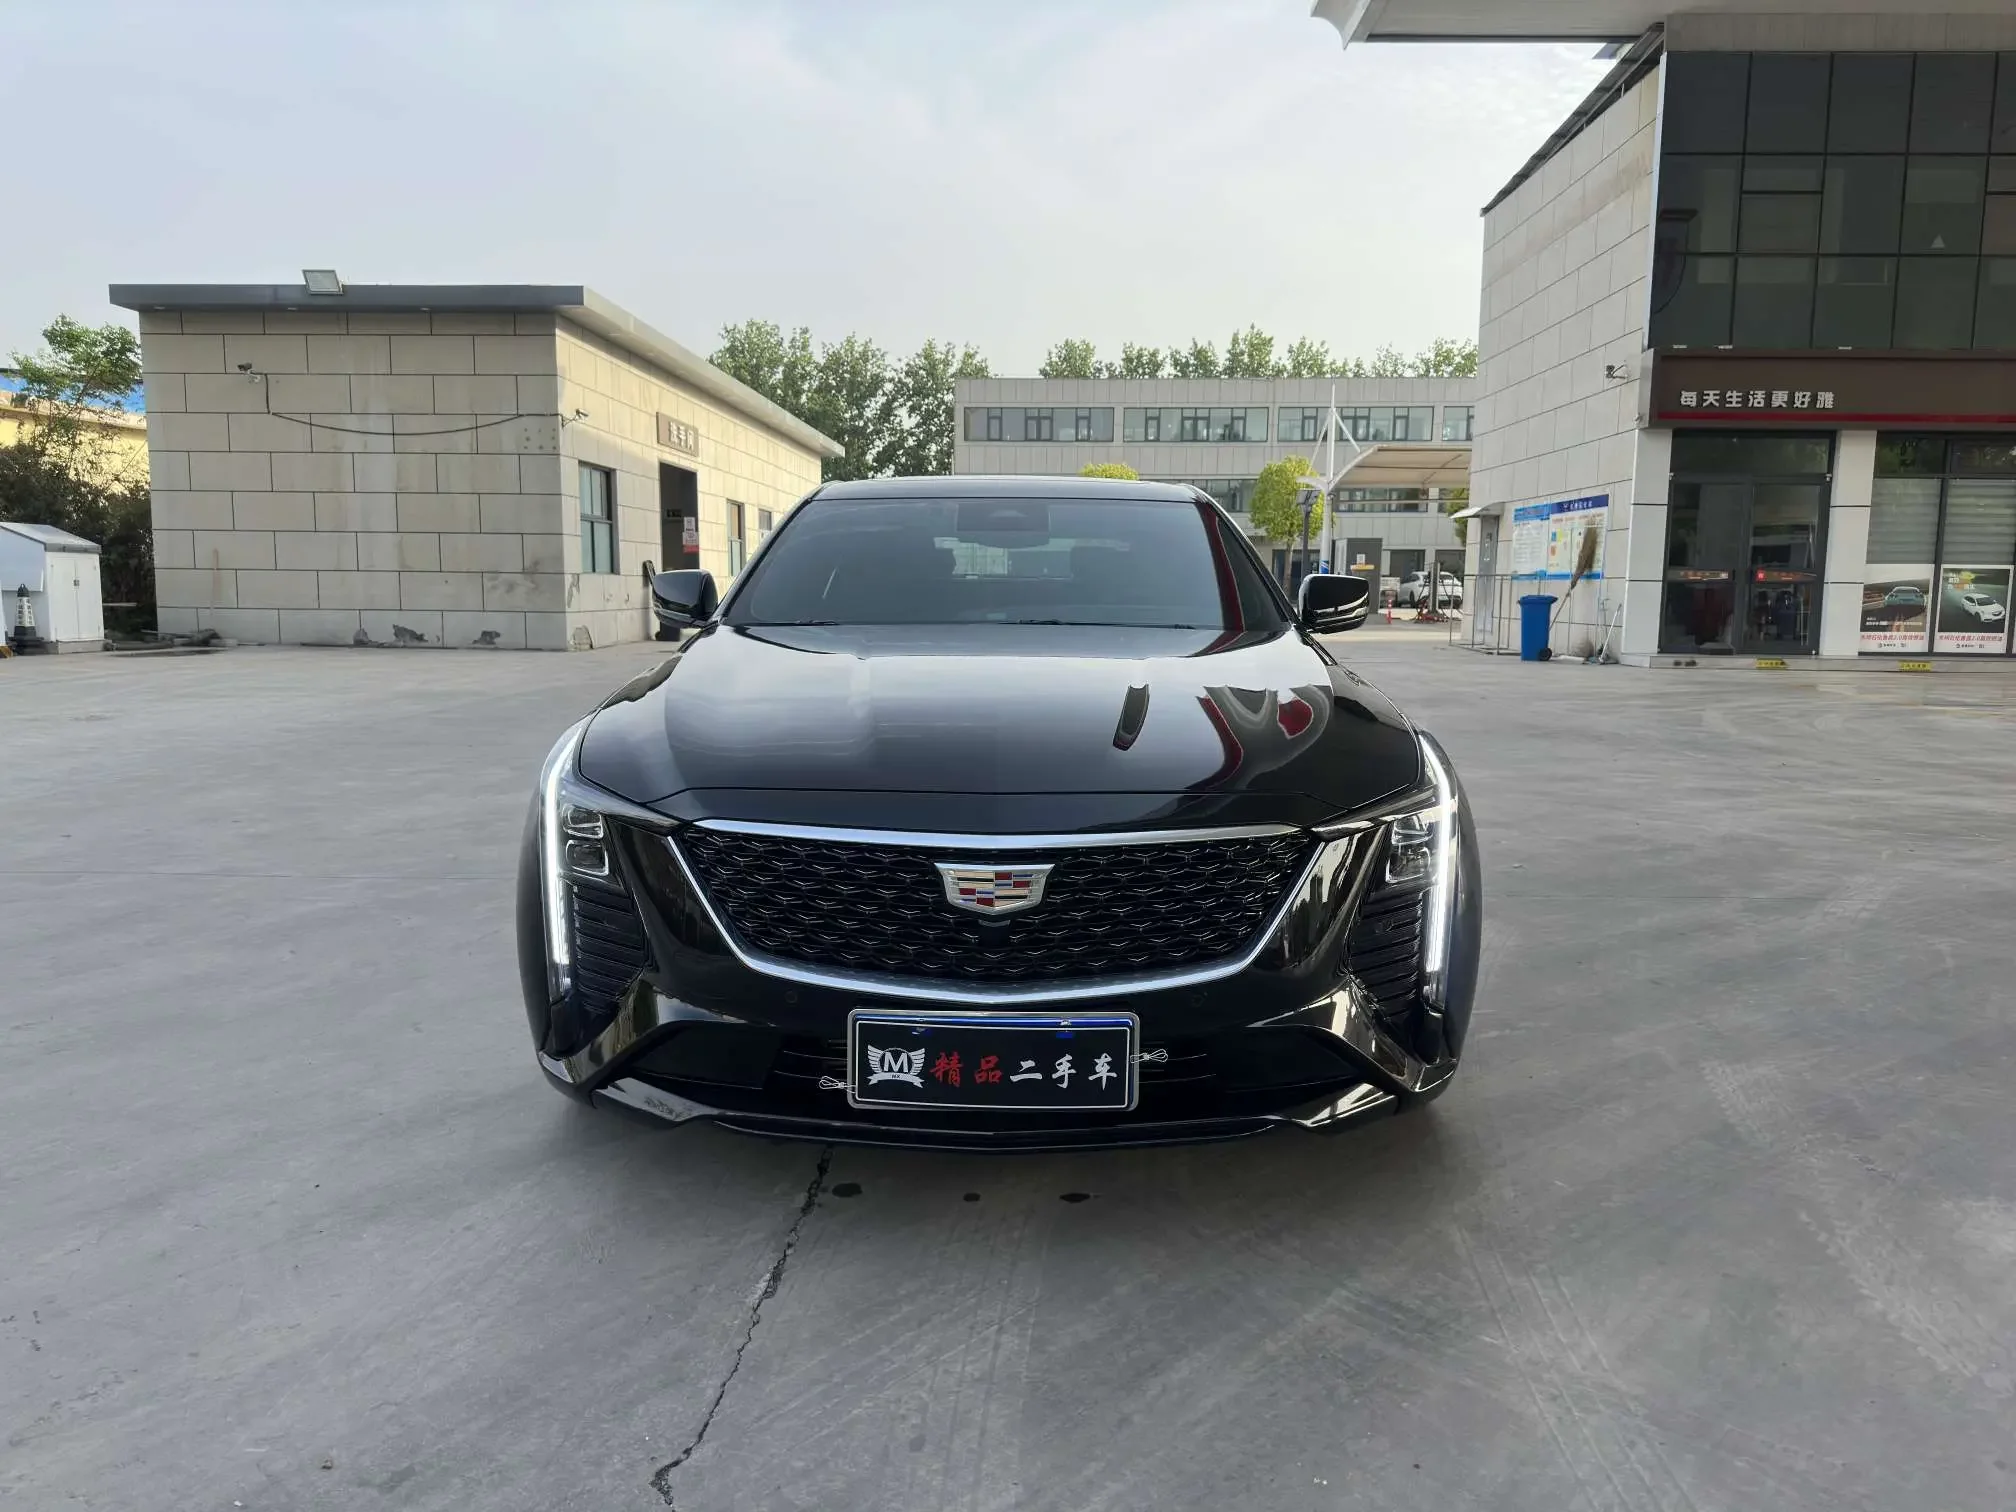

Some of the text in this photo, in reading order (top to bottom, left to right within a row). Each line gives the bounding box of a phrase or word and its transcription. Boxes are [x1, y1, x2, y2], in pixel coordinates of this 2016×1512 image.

[883, 1051, 909, 1073] M
[930, 1051, 1118, 1091] 精品二手车
